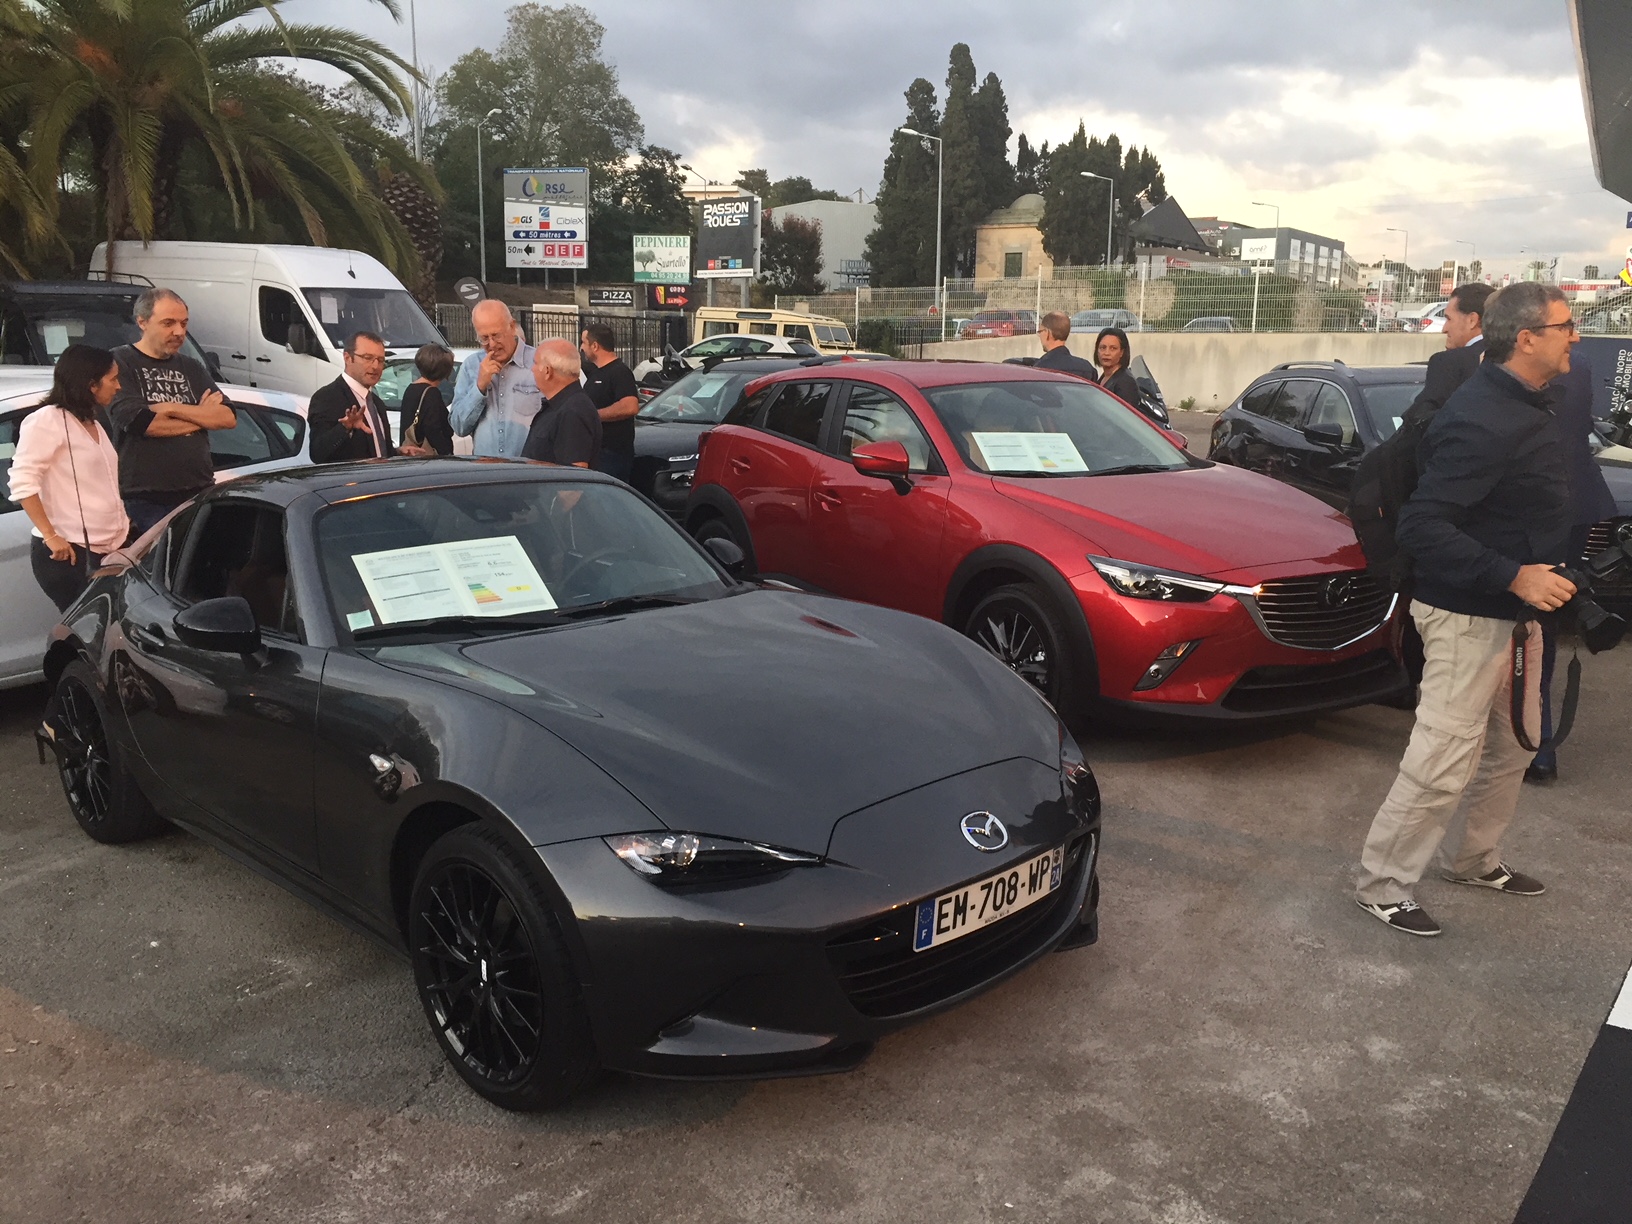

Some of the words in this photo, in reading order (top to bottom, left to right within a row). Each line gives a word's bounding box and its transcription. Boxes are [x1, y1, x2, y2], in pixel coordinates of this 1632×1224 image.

[520, 216, 533, 224] GLS
[556, 217, 585, 225] CibleX
[703, 214, 746, 228] ROUES
[635, 237, 689, 248] PEPINIERE
[507, 246, 523, 254] 50m
[602, 291, 632, 299] PIZZA
[1616, 349, 1627, 373] NORD
[146, 380, 189, 393] PARIS
[1610, 376, 1623, 413] AJACIO
[1514, 646, 1523, 676] Canon
[1051, 868, 1060, 886] 2A
[936, 855, 1050, 936] EM-708-WP
[921, 928, 928, 940] F
